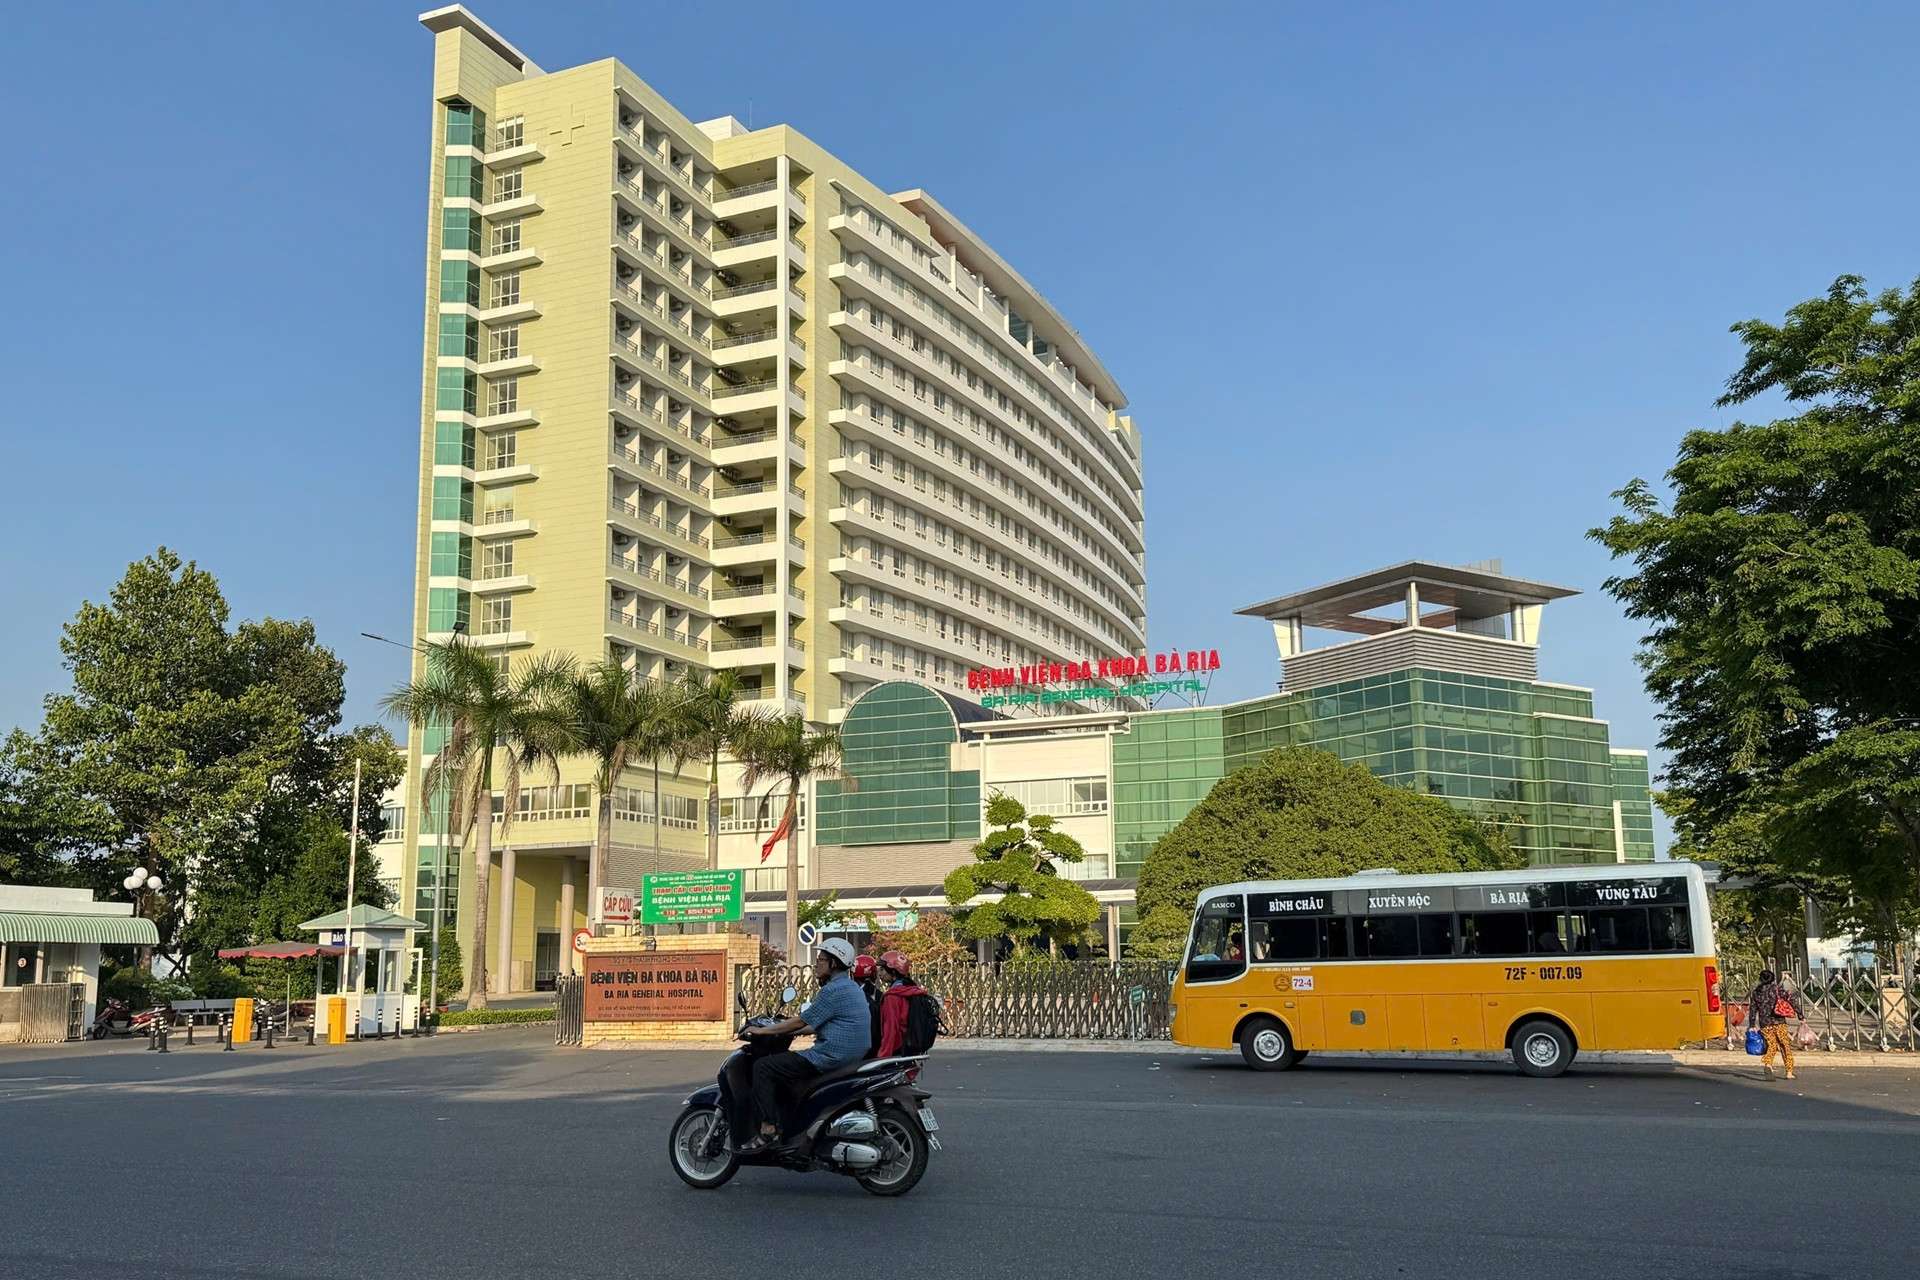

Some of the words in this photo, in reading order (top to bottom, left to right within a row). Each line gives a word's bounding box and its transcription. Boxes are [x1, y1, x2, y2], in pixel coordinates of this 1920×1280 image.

[967, 665, 1015, 692] BỆNH
[1020, 659, 1062, 687] VIỆN
[1067, 660, 1092, 681] ĐA
[1097, 654, 1149, 678] KHOA
[1155, 648, 1182, 673] BÀ
[1186, 649, 1221, 674] RỊA
[981, 695, 1006, 708] BA
[1008, 692, 1037, 706] RIA
[1040, 685, 1115, 704] GENERAL
[1119, 679, 1207, 697] HOSPITAL
[652, 896, 676, 904] BỆNH
[678, 895, 698, 903] VIỆN
[701, 894, 713, 902] BÀ
[715, 894, 731, 902] RỊA
[1490, 891, 1506, 904] BÀ
[1508, 891, 1529, 905] RỊA
[1596, 885, 1630, 900] VŨNG
[1632, 884, 1657, 899] TÀU
[603, 891, 617, 913] CẤP
[618, 892, 632, 913] CỨU
[1211, 901, 1236, 909] SAMCO
[1269, 898, 1293, 912] BÌNH
[1295, 896, 1324, 911] CHÂU
[1369, 894, 1405, 909] XUYÊN
[1407, 893, 1431, 909] MỘC
[590, 970, 615, 986] BỆNH
[617, 969, 638, 986] VIỆN
[641, 971, 654, 984] ĐA
[656, 970, 682, 984] KHOA
[685, 968, 698, 983] BÀ
[701, 970, 718, 985] RỊA
[1504, 967, 1527, 981] 72F
[1293, 978, 1312, 988] 72-4
[604, 990, 614, 999] BA
[617, 990, 629, 999] RIA
[632, 990, 664, 999] GENERAL
[668, 989, 703, 998] HOSPITAL
